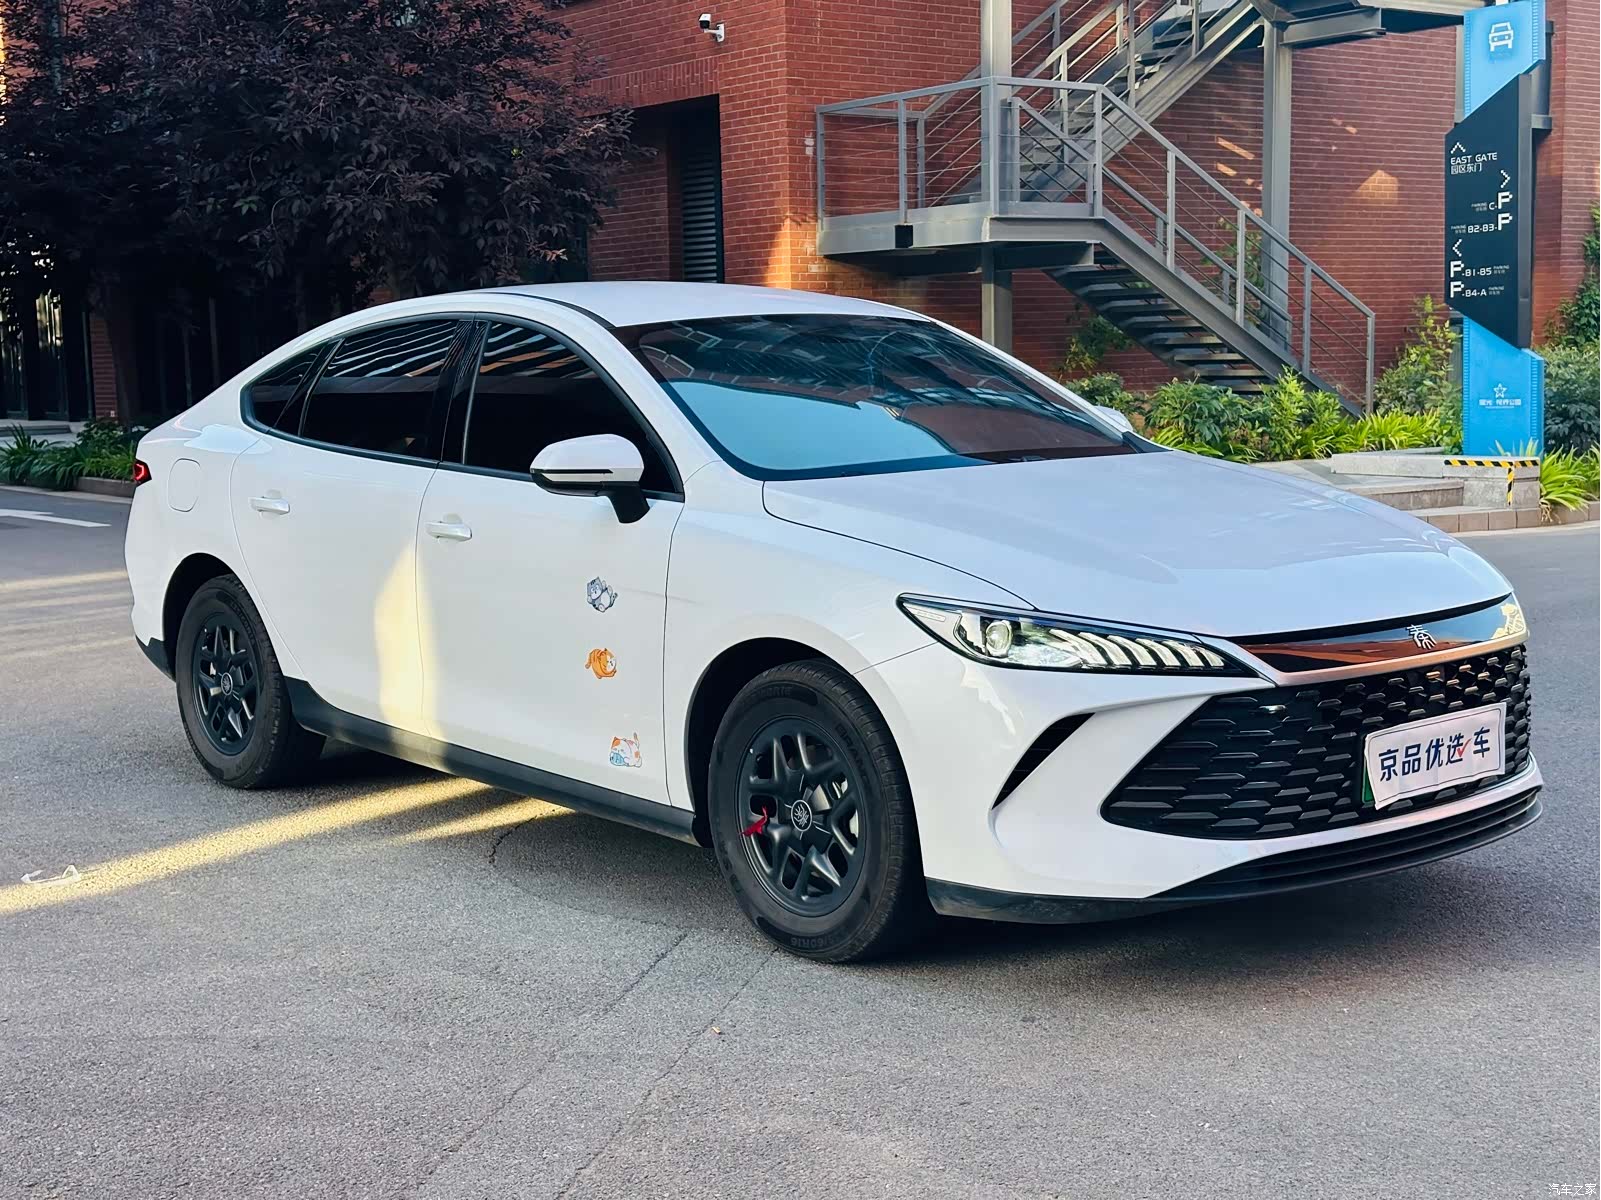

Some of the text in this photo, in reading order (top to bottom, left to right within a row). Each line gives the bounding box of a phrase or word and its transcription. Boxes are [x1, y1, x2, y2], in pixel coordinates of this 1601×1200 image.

[1450, 152, 1498, 165] EAST GATE
[1450, 162, 1482, 175] 园区东门
[1405, 624, 1437, 650] 秦
[1378, 726, 1491, 782] 京品优选车
